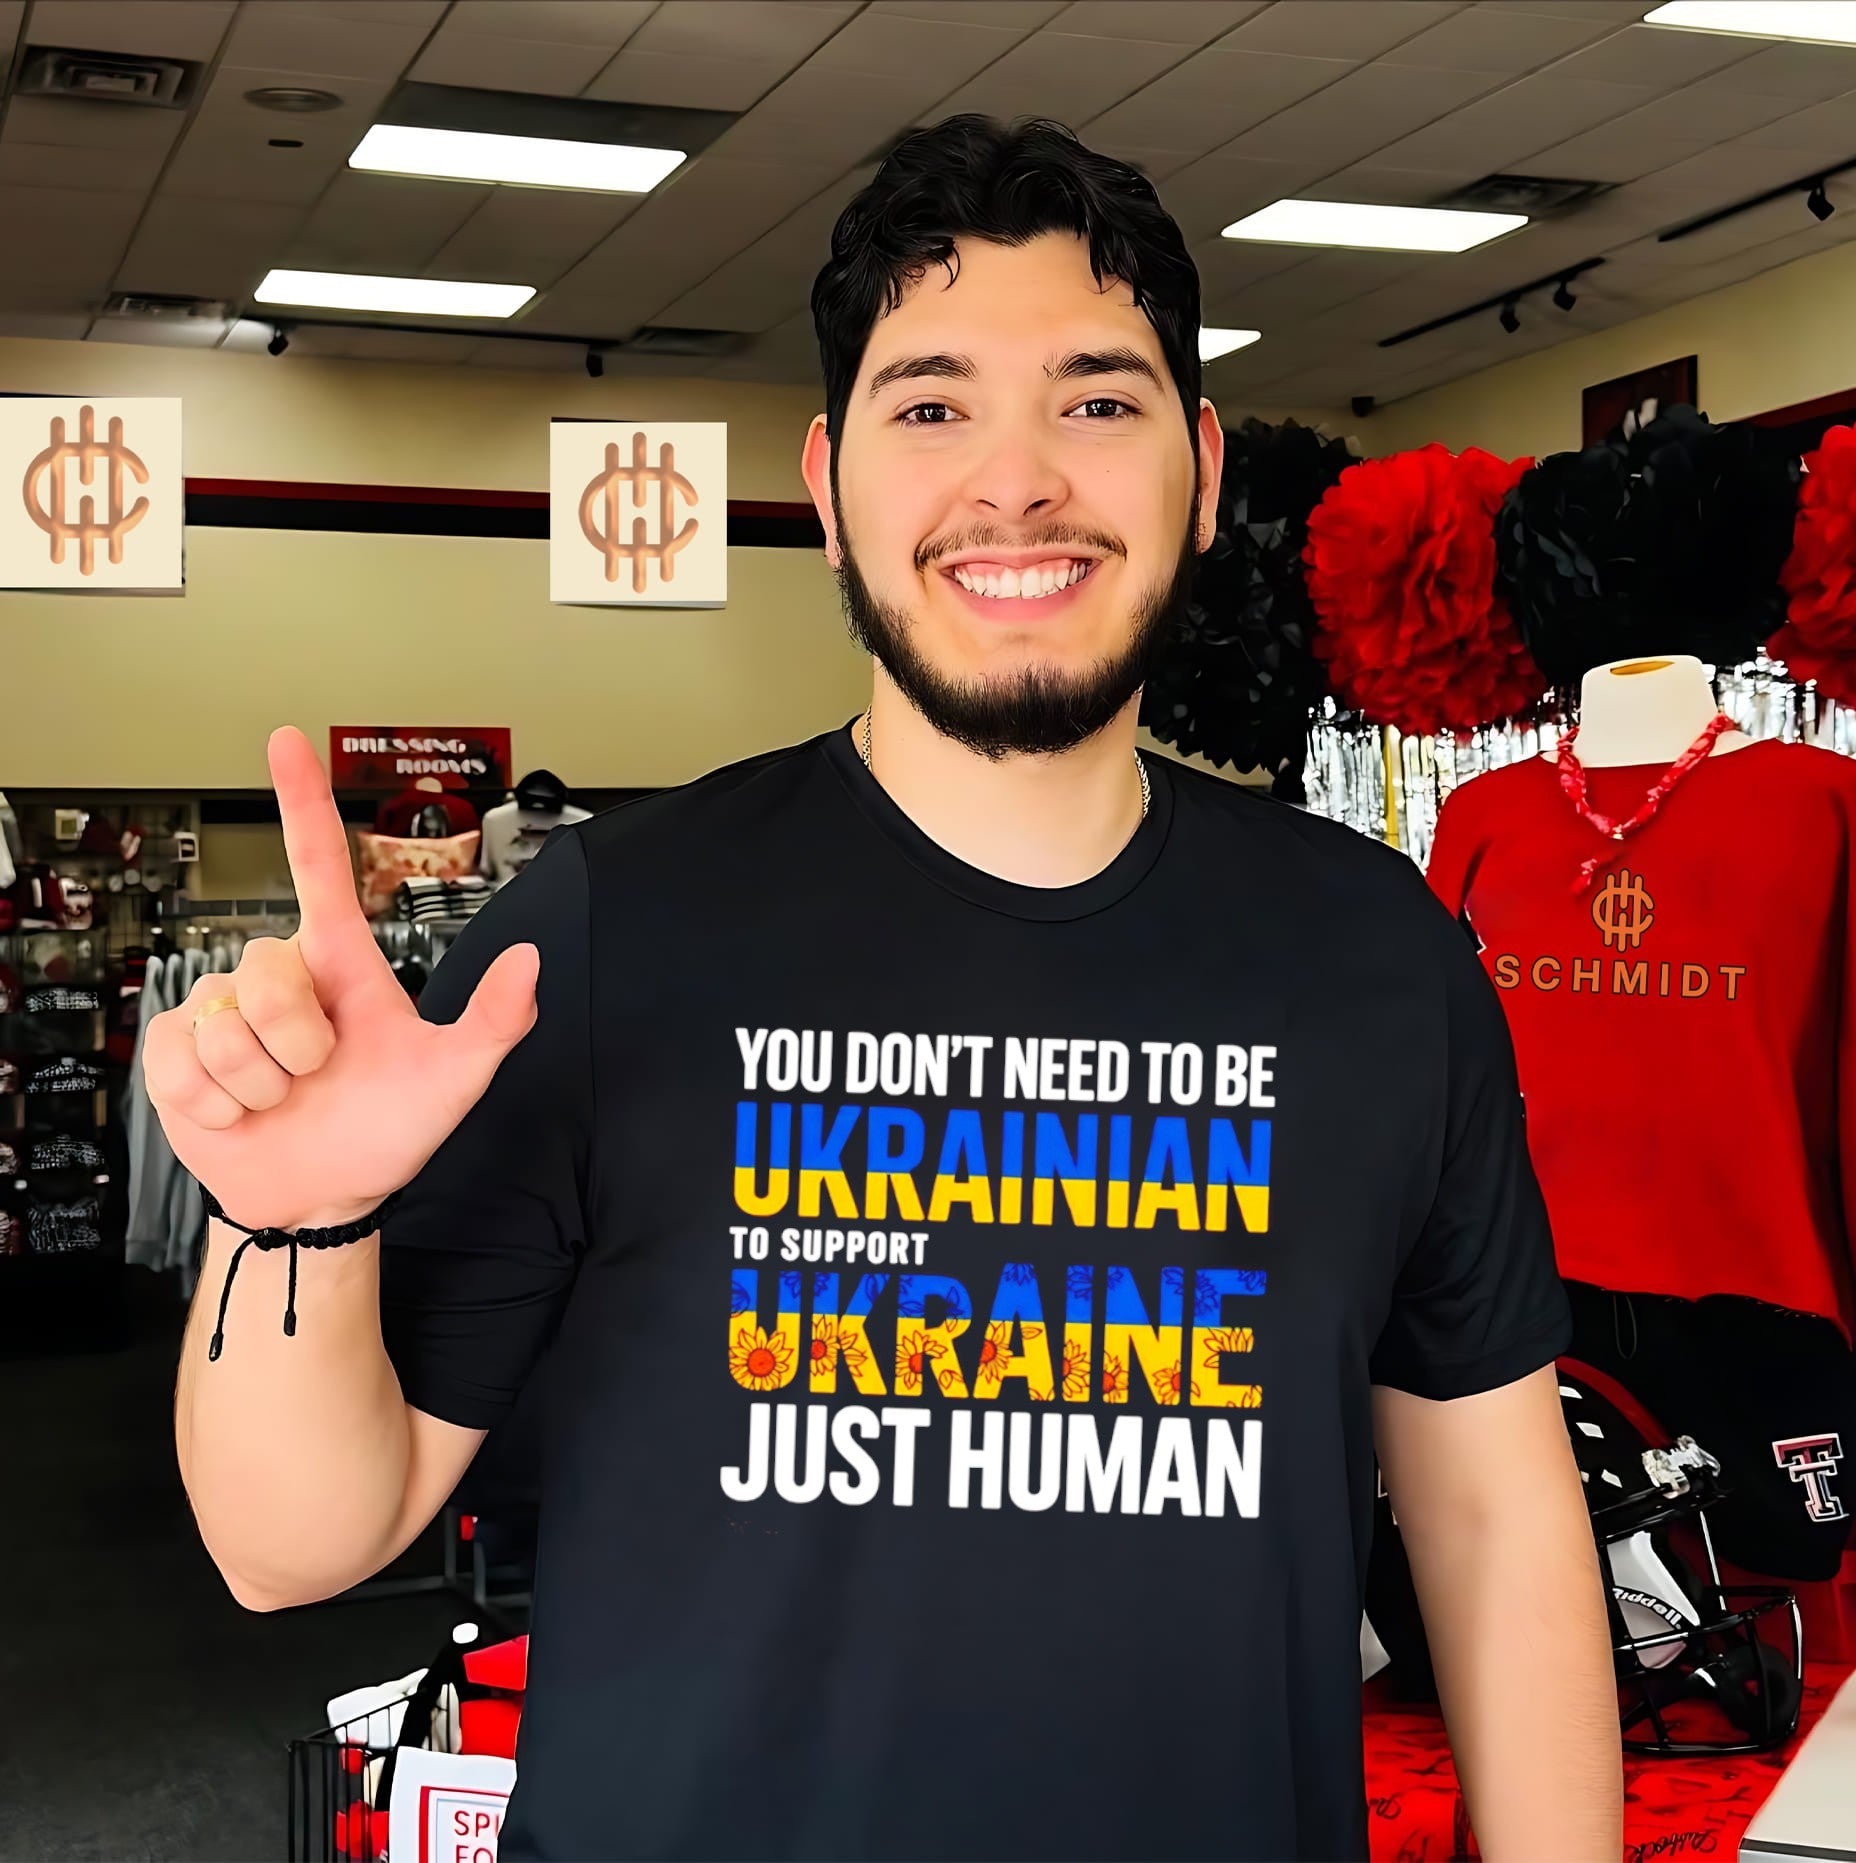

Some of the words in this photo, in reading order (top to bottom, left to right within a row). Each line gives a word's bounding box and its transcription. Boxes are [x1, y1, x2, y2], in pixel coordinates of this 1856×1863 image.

[341, 737, 467, 754] DRESSING
[396, 758, 487, 775] ROOMS
[1494, 953, 1746, 1000] SCHMIDT
[734, 1027, 834, 1092] YOU
[845, 1031, 994, 1098] DON'T
[1003, 1036, 1130, 1103] NEED
[1140, 1041, 1204, 1106] TO
[1214, 1044, 1278, 1108] BE
[733, 1100, 1273, 1234] UKRAINIAN
[728, 1225, 770, 1261] TO
[780, 1227, 930, 1266] SUPPORT
[727, 1263, 1268, 1409] UKRAINE
[719, 1402, 932, 1507] JUST
[948, 1409, 1263, 1519] HUMAN
